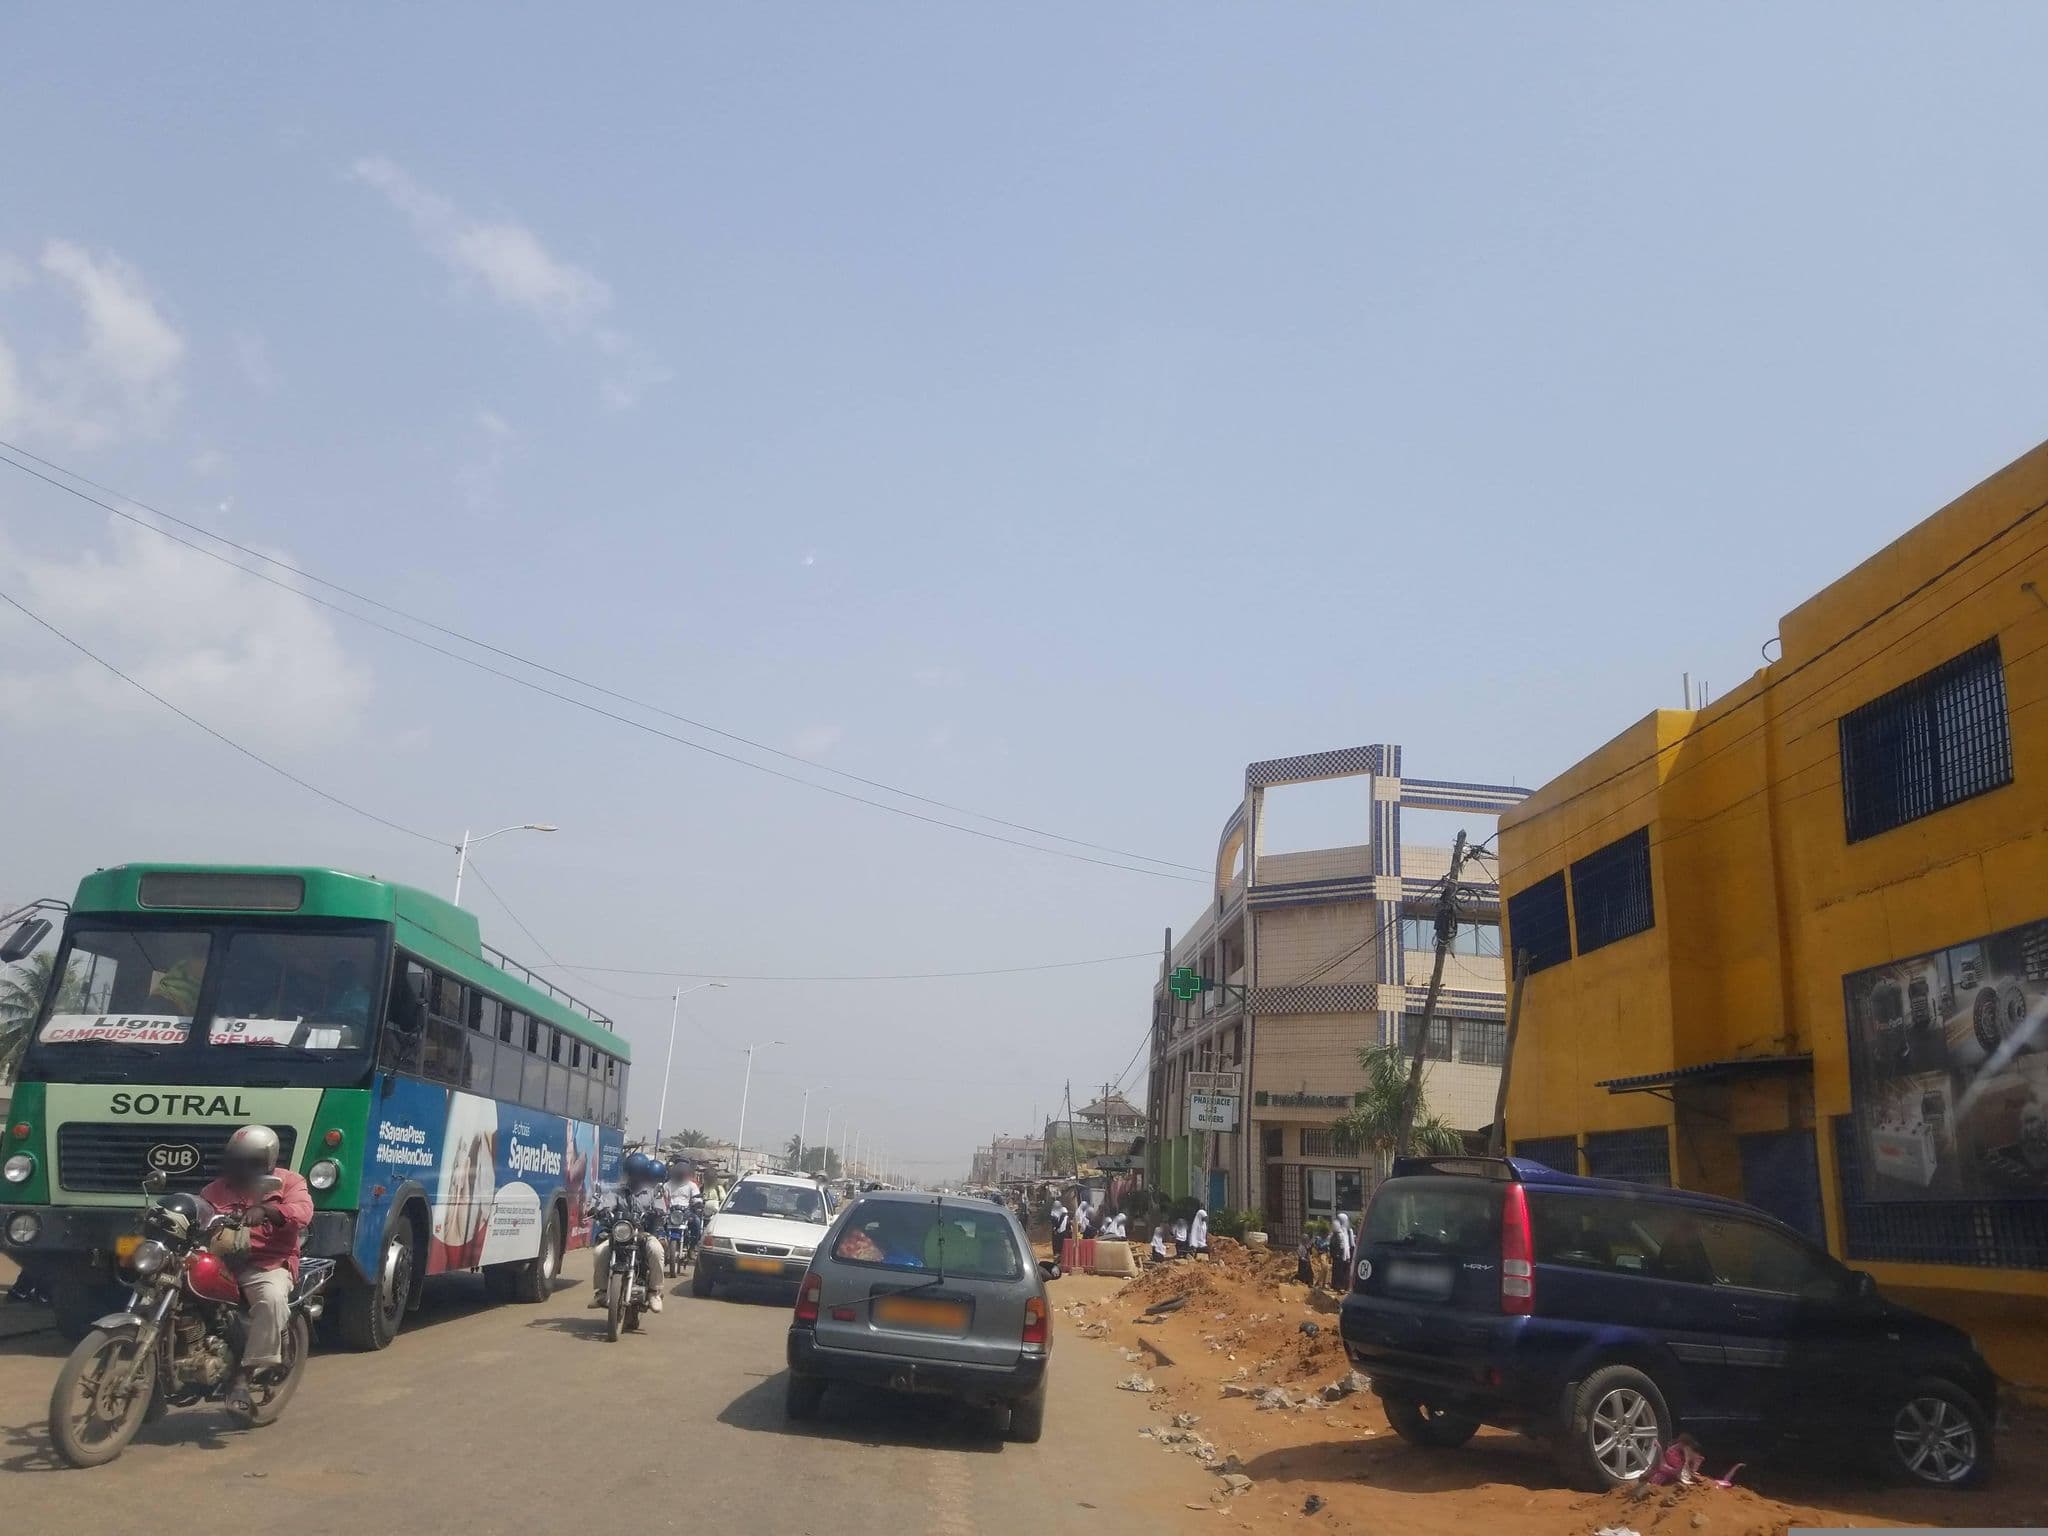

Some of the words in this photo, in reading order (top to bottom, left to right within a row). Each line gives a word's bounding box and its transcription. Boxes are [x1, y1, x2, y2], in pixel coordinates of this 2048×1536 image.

[93, 1017, 191, 1030] Ligne
[224, 1021, 248, 1034] 19
[110, 1093, 251, 1117] SOTRAL
[1193, 1096, 1231, 1106] PHAACIE
[1198, 1114, 1225, 1123] OLERS
[379, 1120, 426, 1145] #SayanaPress
[154, 1150, 193, 1166] SUB
[508, 1136, 540, 1178] Sayana
[540, 1143, 561, 1176] Press
